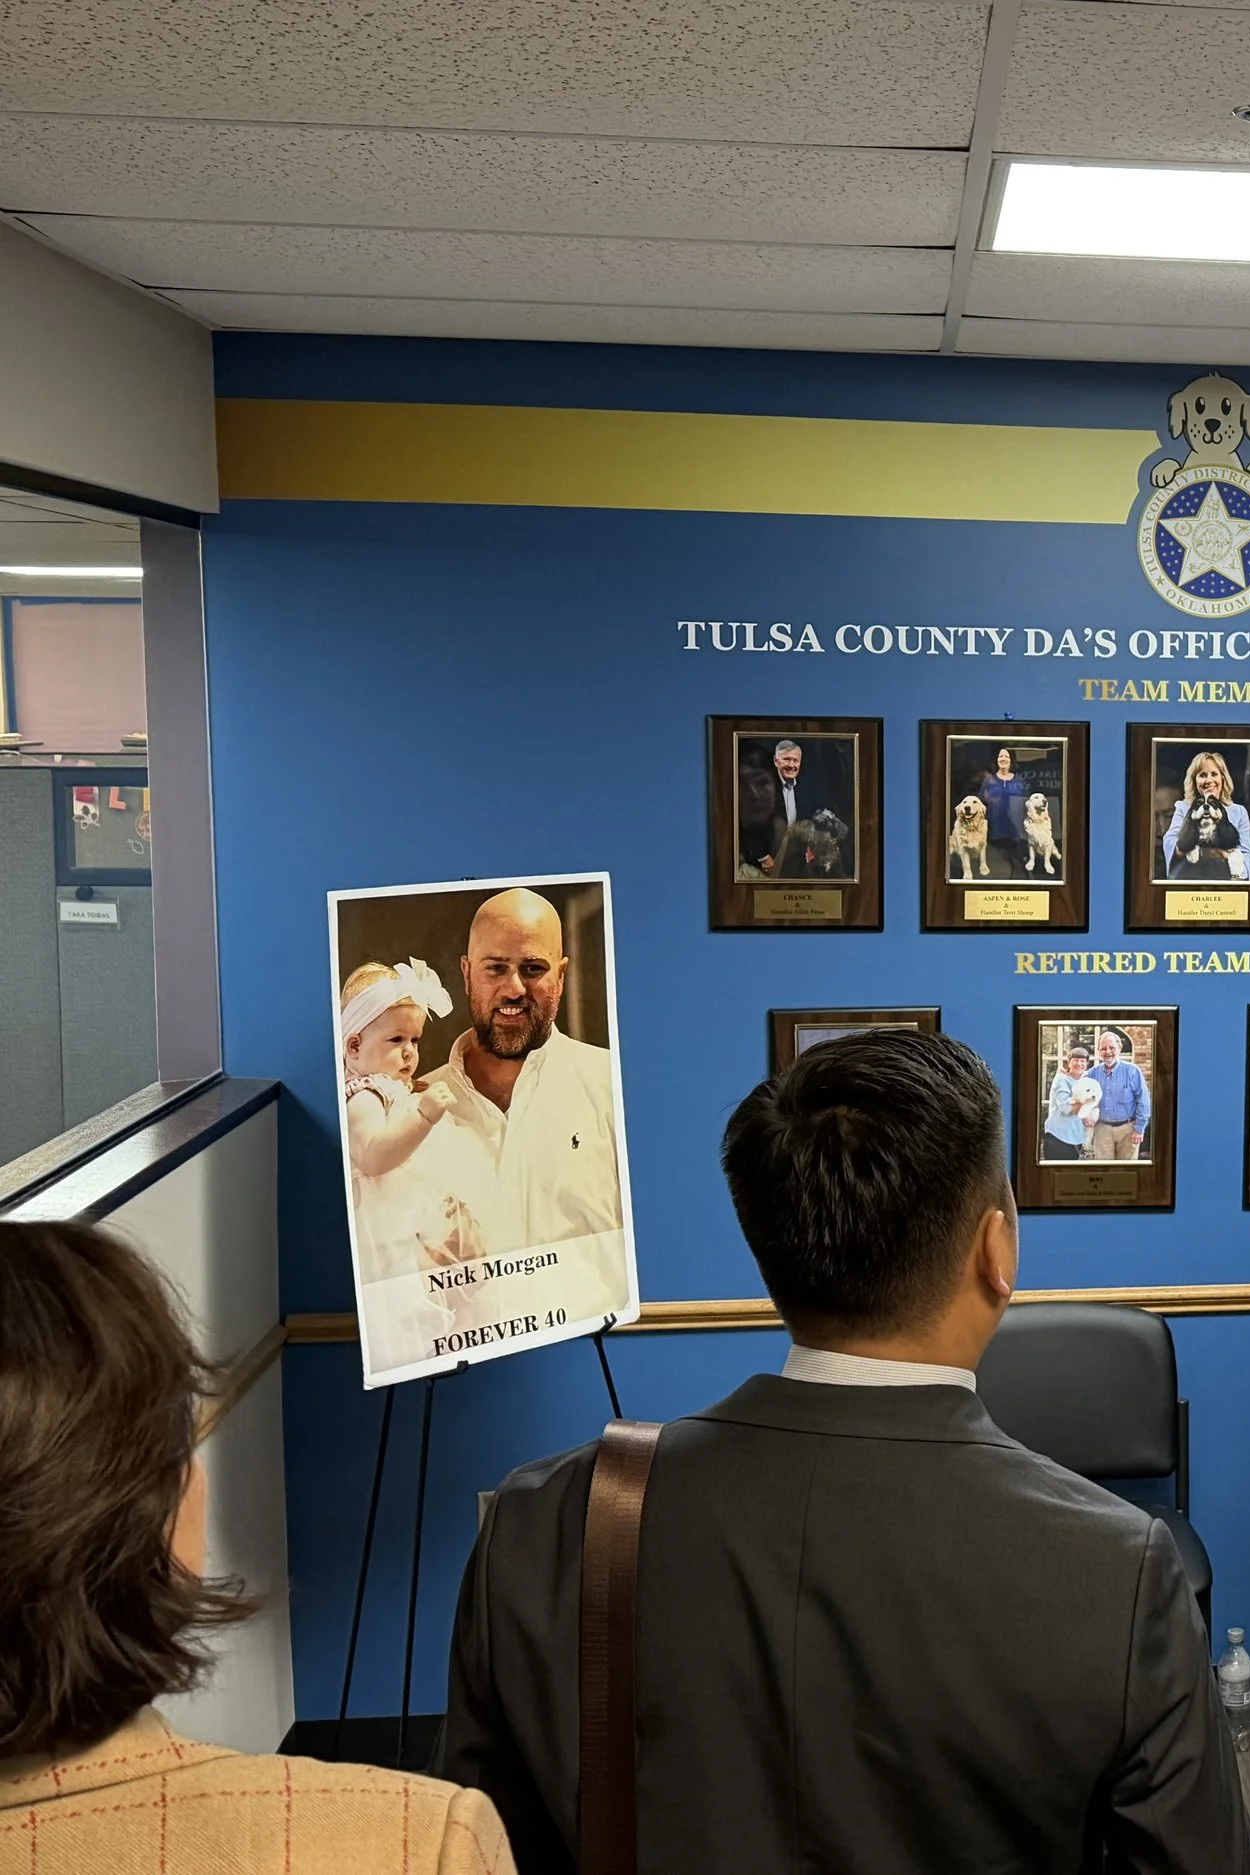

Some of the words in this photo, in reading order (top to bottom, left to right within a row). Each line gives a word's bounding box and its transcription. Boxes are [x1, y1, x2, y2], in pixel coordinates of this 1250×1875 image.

[1145, 473, 1190, 521] COUNTY
[1141, 526, 1158, 575] TULSA
[677, 620, 825, 653] TULSA
[835, 624, 1014, 656] COUNTY
[1023, 627, 1117, 659] DA'S
[1078, 678, 1169, 702] TEAM
[1014, 952, 1157, 974] RETIRED
[428, 1266, 477, 1293] Nick
[482, 1252, 559, 1280] Morgan
[433, 1315, 539, 1356] FOREVER
[544, 1307, 567, 1328] 40
